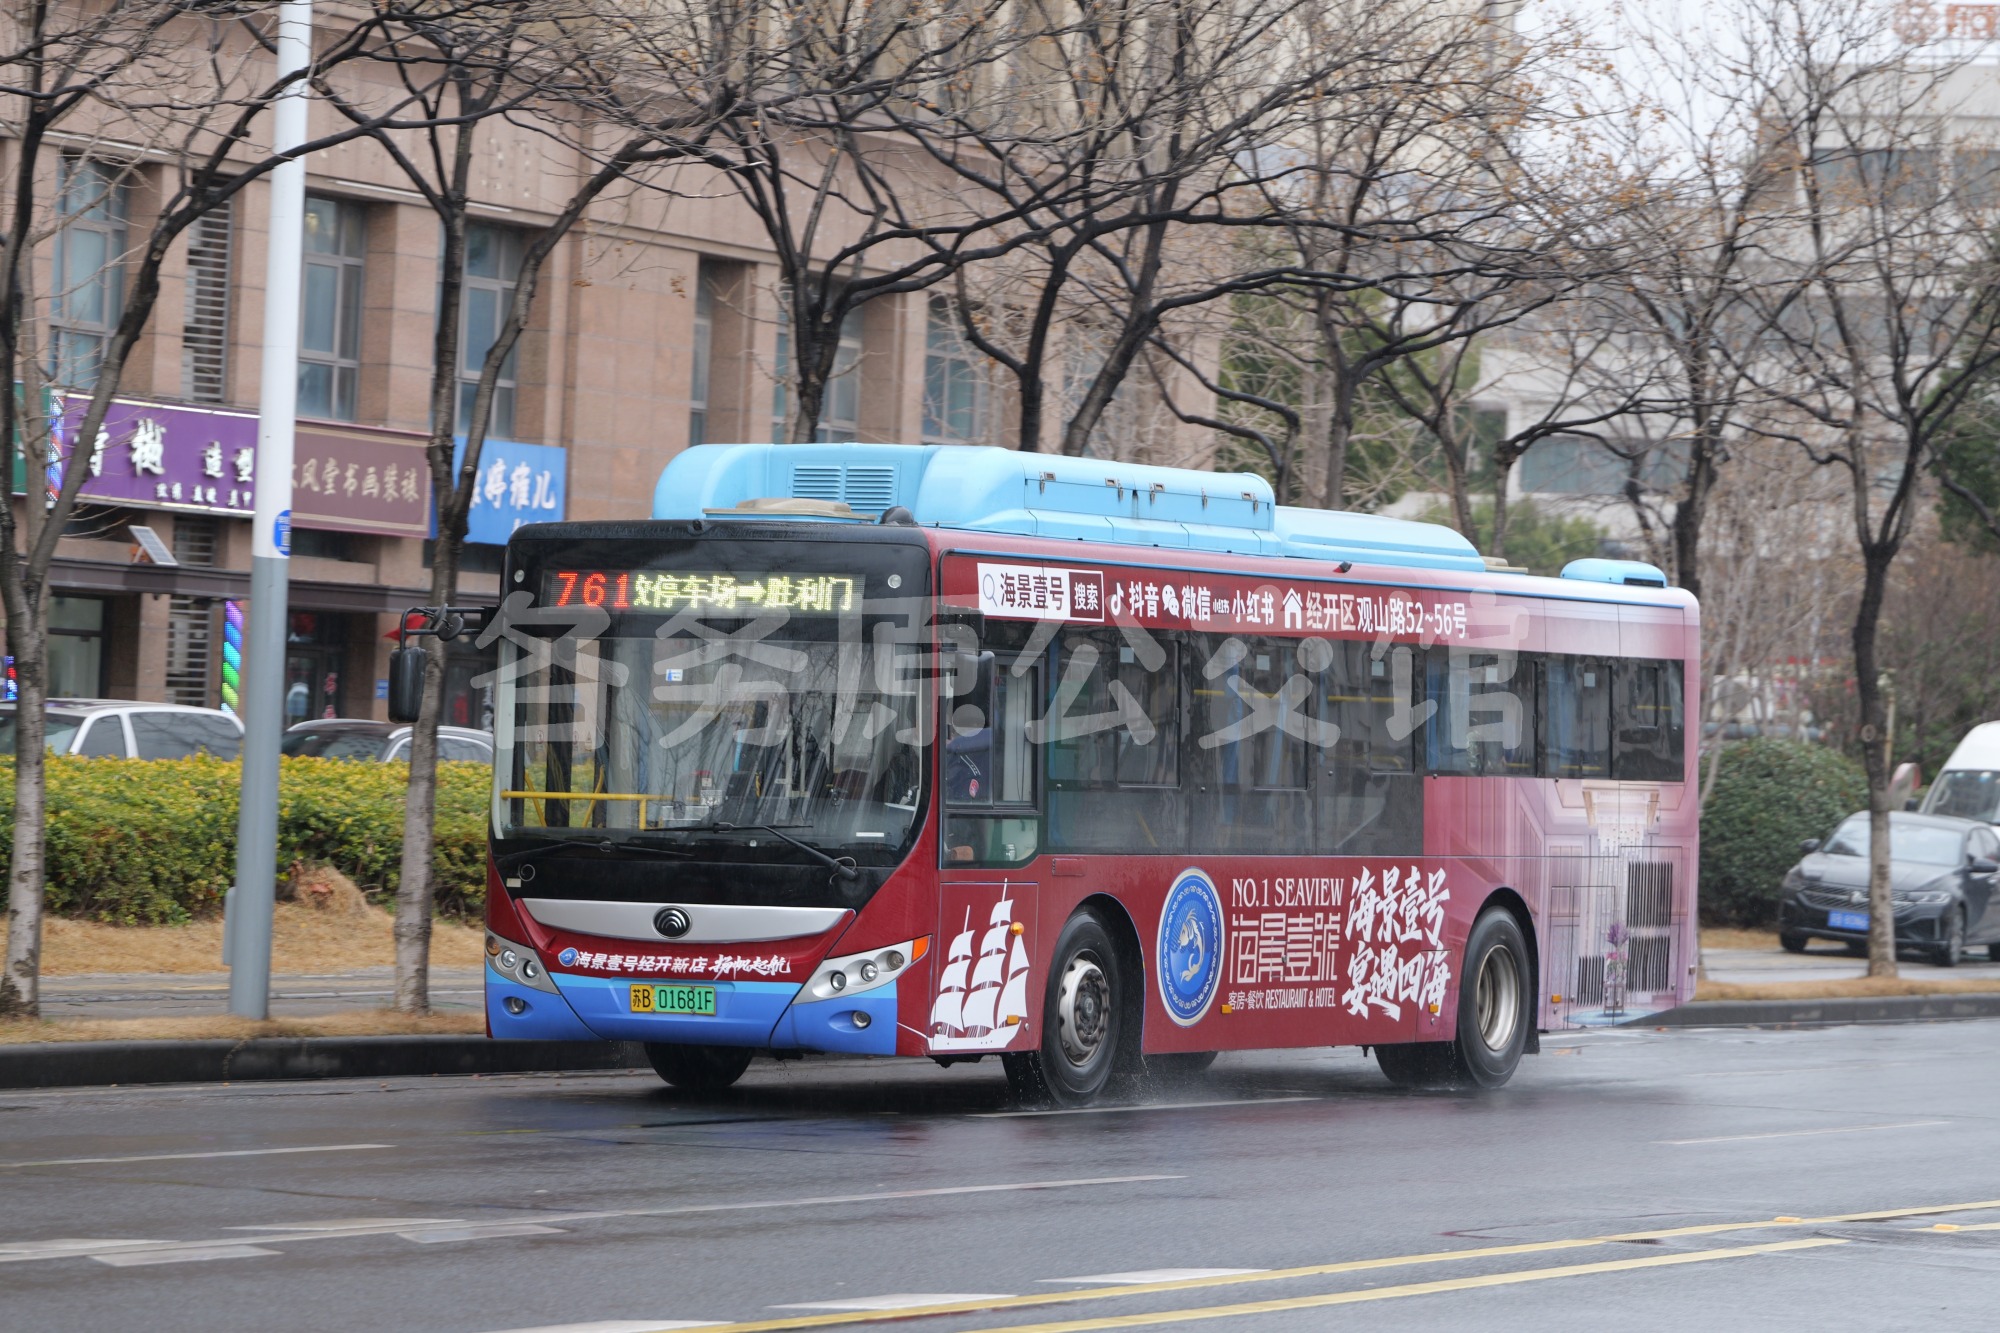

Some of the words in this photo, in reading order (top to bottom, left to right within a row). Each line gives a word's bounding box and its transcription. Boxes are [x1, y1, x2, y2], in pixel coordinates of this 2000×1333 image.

[292, 457, 420, 503] 风堂书画装裱
[556, 572, 630, 608] 761
[763, 575, 853, 612] 胜利门
[1000, 572, 1065, 611] 海景壹号
[1074, 580, 1099, 611] 搜索
[1128, 581, 1159, 619] 抖音
[1181, 584, 1211, 622] 微信
[1232, 588, 1275, 626] 小红书
[1232, 878, 1269, 908] NO.1
[1274, 877, 1344, 908] SEAVIEW
[1344, 865, 1450, 946] 海景壹号
[575, 951, 708, 974] 海景壹号经开新店
[708, 953, 791, 981] 扬帆起航
[1341, 940, 1451, 1023] 宴遇四海
[632, 988, 651, 1008] 苏B
[658, 989, 713, 1011] 01681F
[1265, 988, 1308, 1010] RESTAURANT
[1309, 990, 1314, 1007] &
[1315, 987, 1336, 1008] HOTEL
